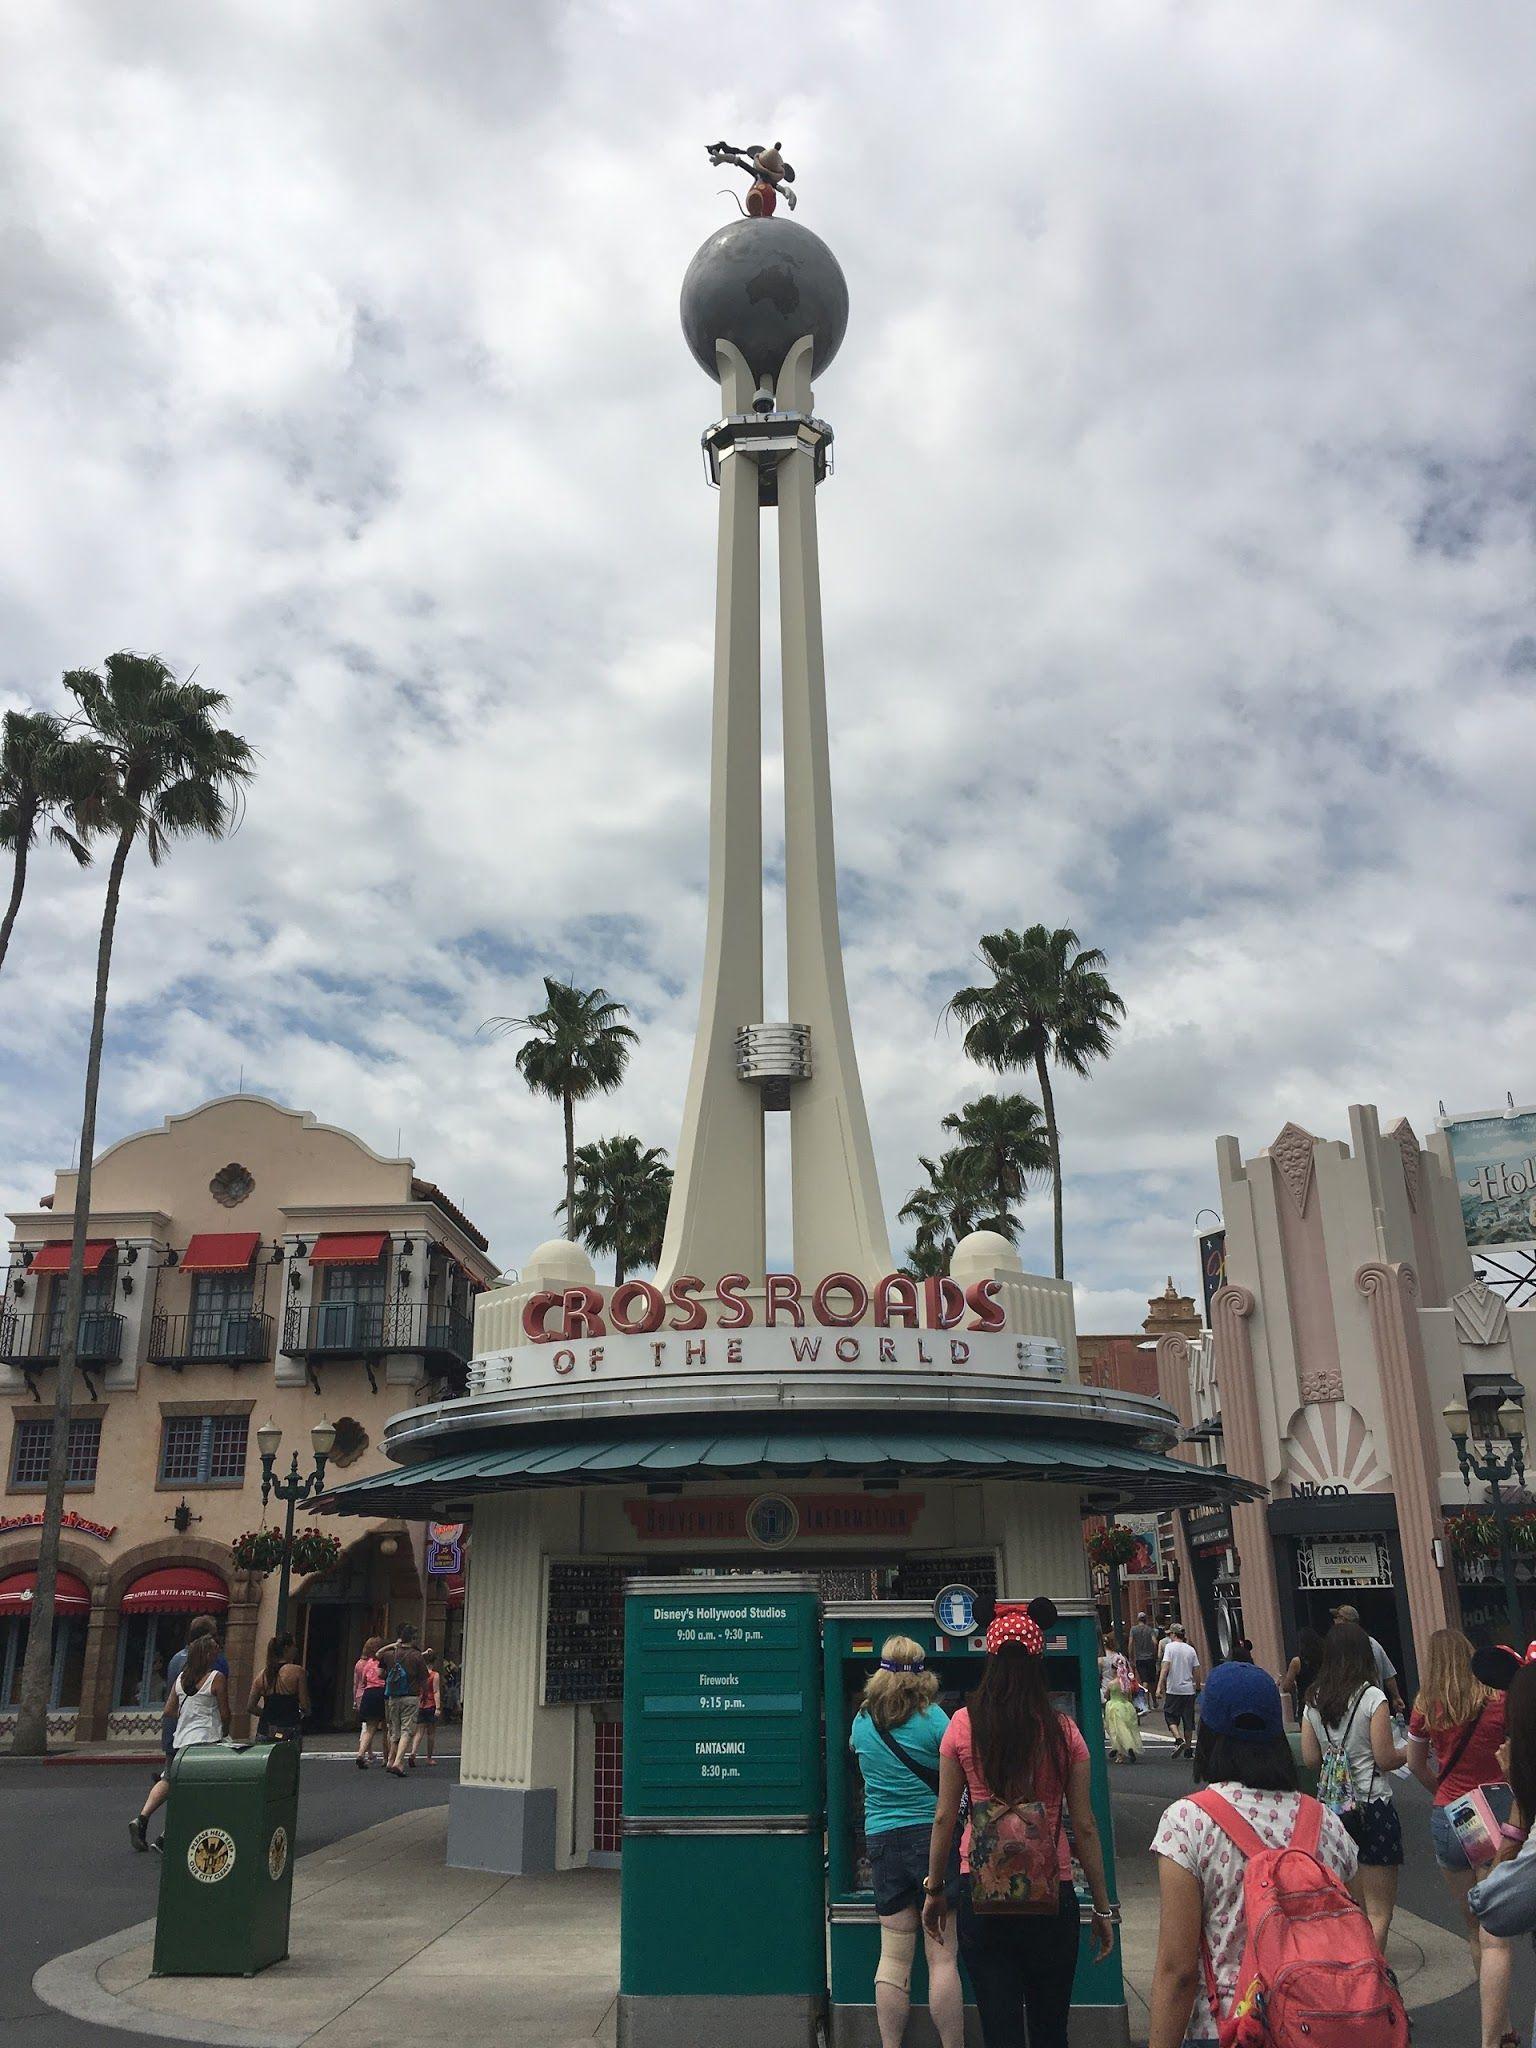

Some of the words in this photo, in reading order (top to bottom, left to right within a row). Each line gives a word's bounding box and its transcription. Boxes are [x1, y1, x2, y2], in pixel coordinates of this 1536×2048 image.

[1469, 1156, 1536, 1204] Hol
[522, 1272, 1007, 1344] CROSSROADS
[553, 1346, 604, 1375] OF
[650, 1337, 742, 1367] THE
[790, 1335, 970, 1365] WORLD
[1291, 1482, 1349, 1499] Nikon
[1324, 1555, 1368, 1565] DARKROOM
[134, 1590, 159, 1598] APPAREL
[654, 1607, 694, 1621] Disney's
[697, 1607, 747, 1621] Hollywood
[750, 1606, 787, 1618] Studios
[677, 1629, 695, 1641] 9:00
[698, 1632, 716, 1640] a.m.
[725, 1628, 743, 1640] 9:30
[745, 1631, 764, 1642] p.m.
[700, 1673, 739, 1685] Fireworks
[700, 1696, 721, 1708] 9:15
[725, 1699, 745, 1710] p.m.
[696, 1742, 745, 1754] FANTASMIC!
[702, 1765, 720, 1776] 8:30
[722, 1767, 740, 1779] p.m.
[191, 1831, 209, 1850] PLEASE
[210, 1830, 225, 1838] HELP
[225, 1837, 234, 1853] KEEP
[189, 1861, 199, 1875] OUR
[199, 1873, 213, 1881] CITY
[214, 1864, 231, 1880] CLEAN
